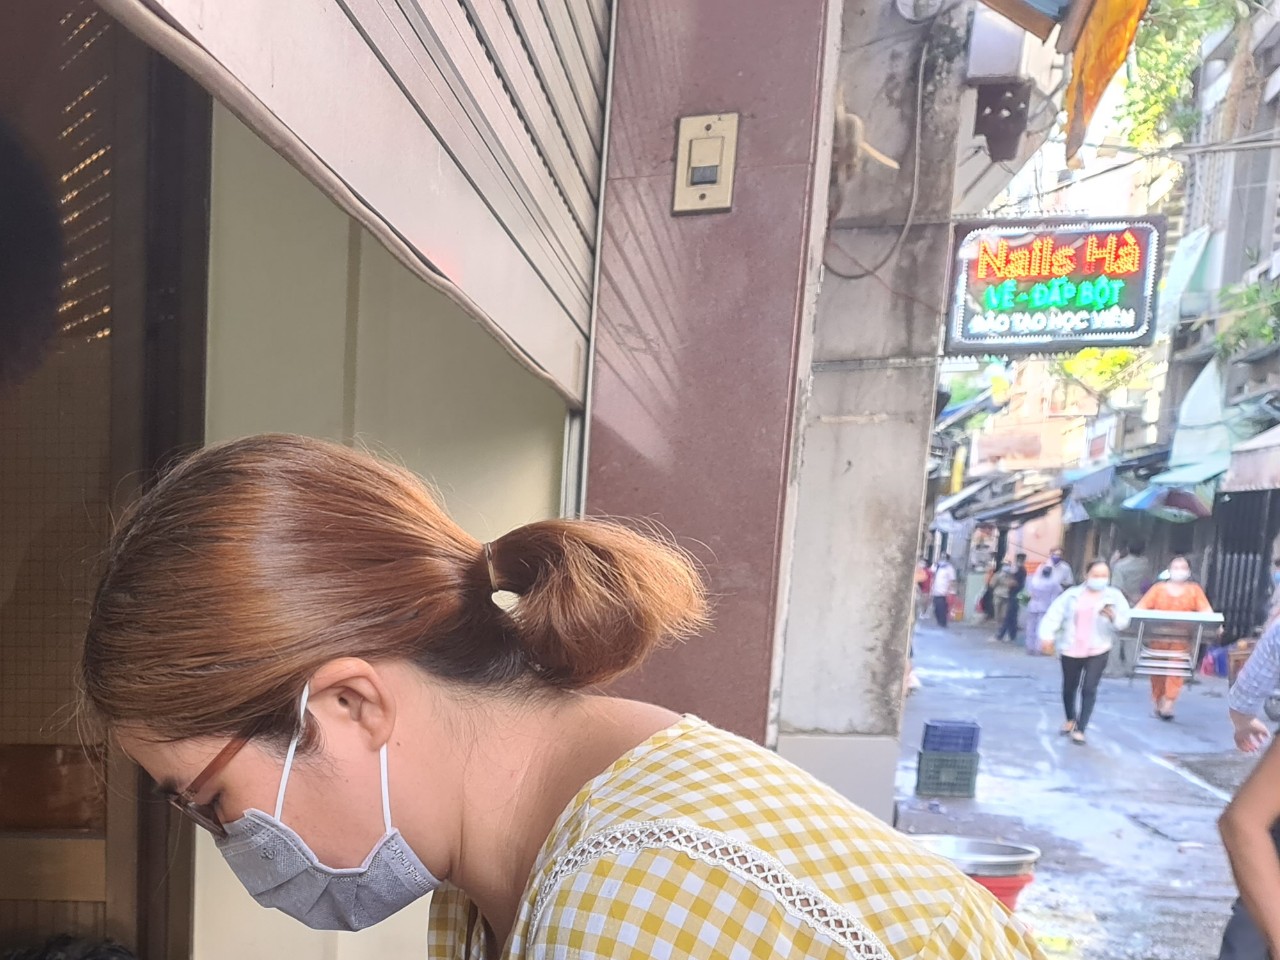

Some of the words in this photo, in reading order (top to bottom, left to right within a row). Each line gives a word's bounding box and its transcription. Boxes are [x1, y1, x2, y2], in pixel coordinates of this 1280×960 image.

[976, 236, 1077, 279] Nails
[1084, 229, 1140, 274] Hà
[1076, 274, 1125, 311] BỘT
[1047, 308, 1090, 334] HỌC
